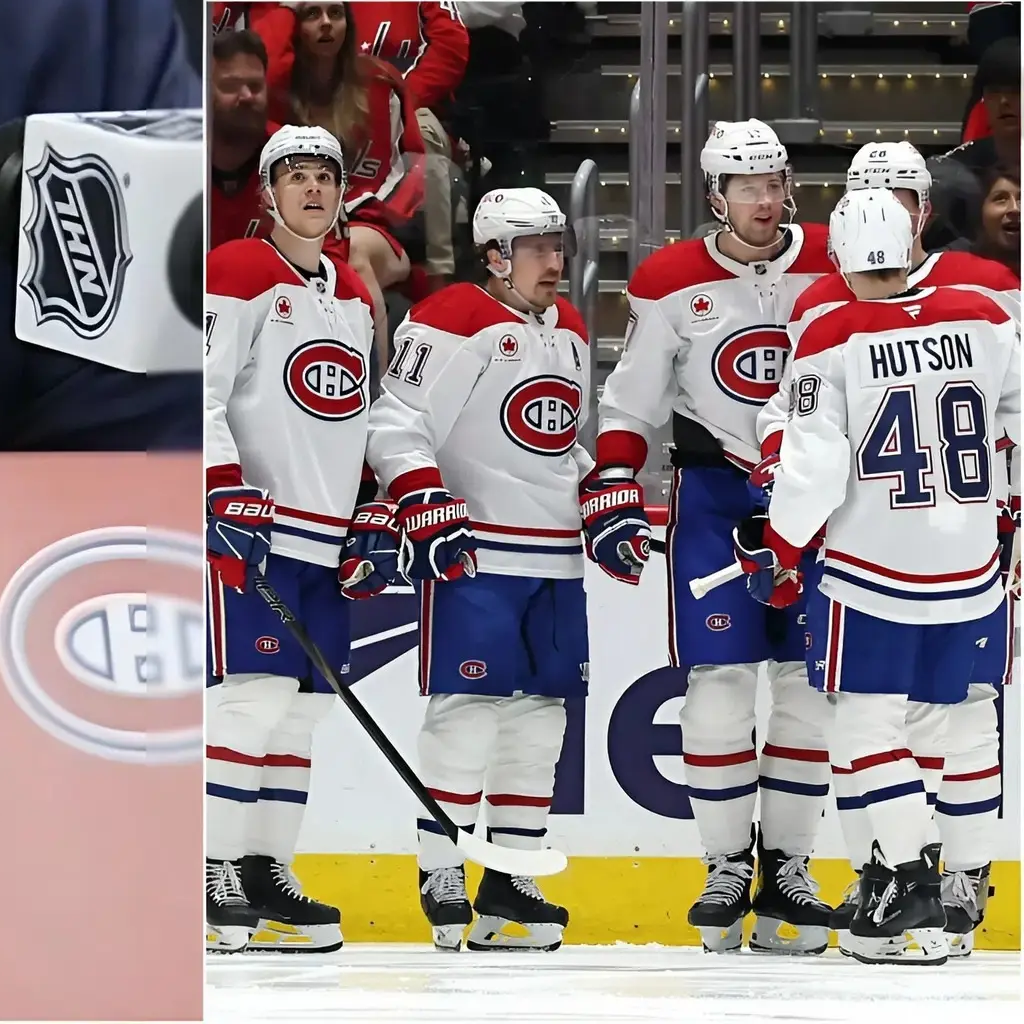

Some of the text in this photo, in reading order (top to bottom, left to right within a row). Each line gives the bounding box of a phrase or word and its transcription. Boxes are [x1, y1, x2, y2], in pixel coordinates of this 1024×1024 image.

[52, 185, 106, 298] NHL
[866, 249, 886, 266] 48
[387, 336, 433, 387] 11
[869, 333, 974, 379] HUTSON
[788, 373, 822, 419] 8
[856, 379, 993, 510] 48
